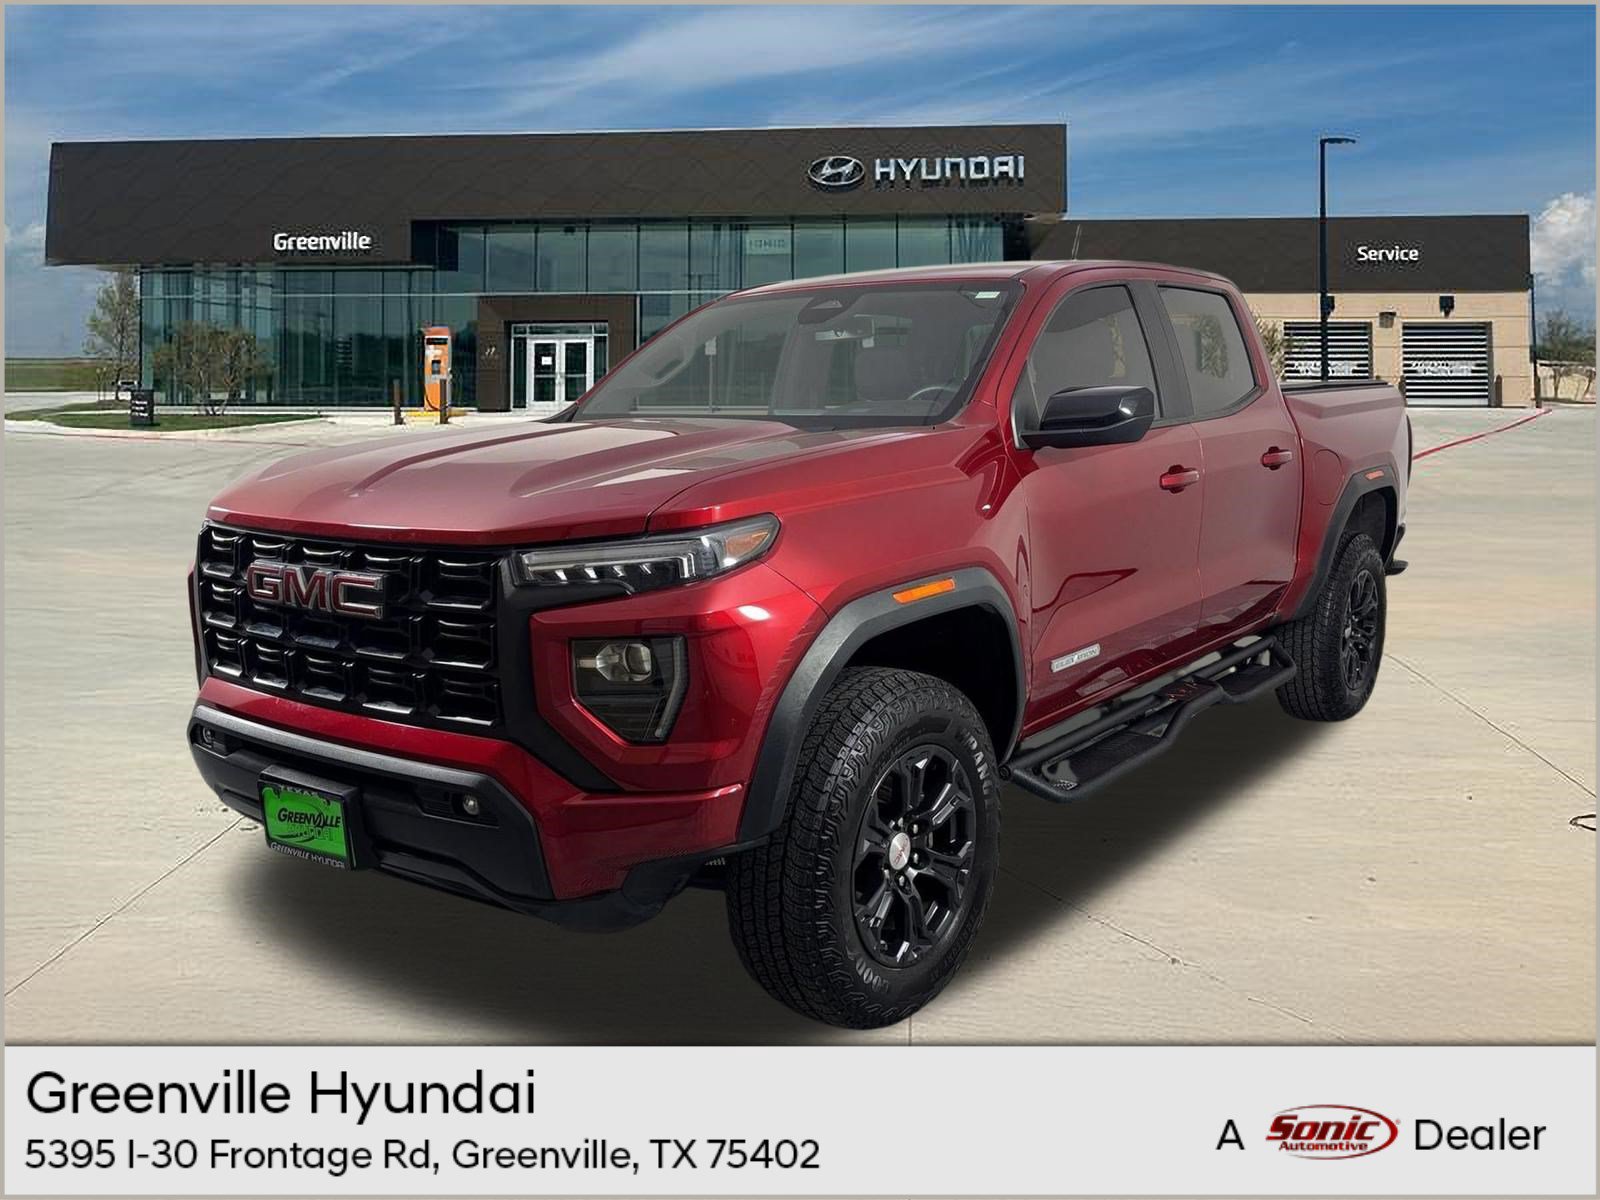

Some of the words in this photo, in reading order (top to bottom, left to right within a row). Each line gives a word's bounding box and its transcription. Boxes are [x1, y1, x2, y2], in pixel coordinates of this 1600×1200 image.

[875, 156, 1025, 181] HYUNDAI
[273, 231, 372, 251] Greenville
[1357, 245, 1419, 261] Service
[246, 560, 384, 620] GMC
